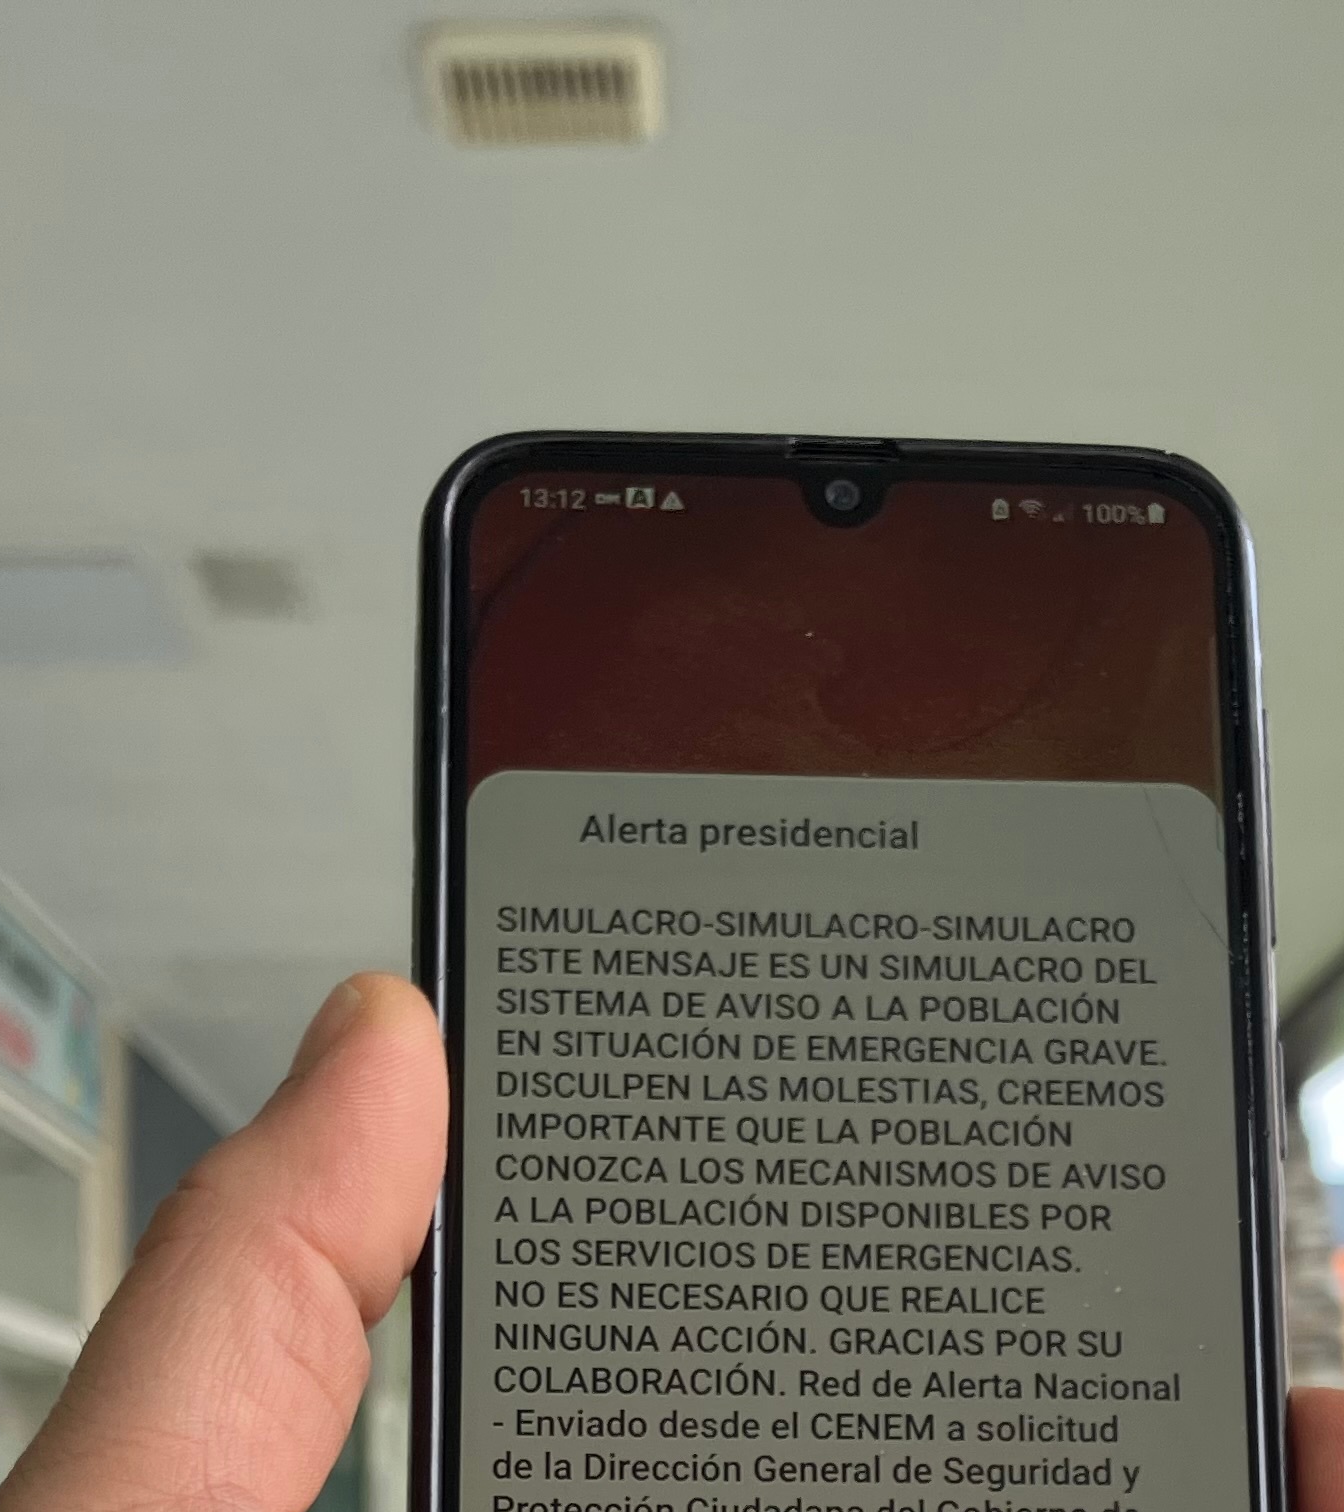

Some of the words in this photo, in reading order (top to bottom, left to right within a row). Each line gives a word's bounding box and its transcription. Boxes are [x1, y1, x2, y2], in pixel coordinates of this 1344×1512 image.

[520, 487, 587, 510] 13:12
[1082, 504, 1146, 525] 100%
[579, 812, 688, 845] Alerta
[699, 817, 919, 854] presidencial
[496, 905, 1136, 944] SIMULACRO-SIMULACRO-SIMULACRO
[497, 946, 583, 975] ESTE
[592, 948, 759, 979] MENSAJE
[769, 952, 811, 979] ES
[820, 953, 868, 981] UN
[879, 953, 1083, 984] SIMULACRO
[1095, 957, 1158, 985] DEL
[496, 987, 651, 1018] SISTEMA
[662, 991, 707, 1019] DE
[715, 992, 821, 1021] AVISO
[830, 994, 856, 1021] A
[865, 994, 909, 1022] LA
[919, 991, 1120, 1025] POBLACIÓN
[496, 1029, 541, 1057] EN
[552, 1026, 741, 1060] SITUACIÓN
[753, 1034, 797, 1062] DE
[807, 1034, 1034, 1065] EMERGENCIA
[1044, 1038, 1168, 1067] GRAVE.
[496, 1070, 690, 1101] DISCULPEN
[703, 1074, 768, 1103] LAS
[779, 1076, 988, 1111] MOLESTIAS,
[997, 1078, 1165, 1108] CREEMOS
[496, 1112, 726, 1143] IMPORTANTE
[735, 1116, 807, 1147] QUE
[816, 1117, 860, 1145] LA
[870, 1113, 1072, 1148] POBLACIÓN
[495, 1153, 669, 1184] CONOZCA
[679, 1156, 745, 1185] LOS
[755, 1158, 997, 1189] MECANISMOS
[1007, 1161, 1052, 1189] DE
[1060, 1162, 1166, 1191] AVISO
[493, 1195, 519, 1223] A
[530, 1196, 574, 1224] LA
[585, 1193, 789, 1228] POBLACIÓN
[801, 1200, 1030, 1231] DISPONIBLES
[1040, 1203, 1112, 1232] POR
[495, 1237, 561, 1266] LOS
[571, 1238, 757, 1269] SERVICIOS
[767, 1242, 811, 1270] DE
[821, 1242, 1081, 1273] EMERGENCIAS.
[495, 1279, 546, 1309] NO
[557, 1280, 599, 1310] ES
[610, 1282, 809, 1313] NECESARIO
[819, 1284, 891, 1316] QUE
[901, 1285, 1046, 1315] REALICE
[494, 1322, 660, 1353] NINGUNA
[669, 1319, 817, 1355] ACCIÓN.
[829, 1327, 985, 1357] GRACIAS
[995, 1329, 1068, 1358] POR
[1076, 1329, 1123, 1358] SU
[493, 1361, 786, 1397] COLABORACIÓN.
[799, 1368, 861, 1398] Red
[871, 1368, 913, 1399] de
[922, 1369, 1023, 1400] Alerta
[1034, 1372, 1181, 1402] Nacional
[515, 1408, 648, 1438] Enviado
[658, 1409, 761, 1440] desde
[770, 1410, 799, 1440] el
[810, 1412, 935, 1441] CENEM
[946, 1420, 966, 1442] a
[976, 1413, 1119, 1444] solicitud
[492, 1450, 533, 1480] de
[544, 1450, 573, 1481] la
[584, 1452, 742, 1483] Dirección
[753, 1454, 881, 1485] General
[892, 1455, 933, 1485] de
[943, 1456, 1112, 1493] Seguridad
[1122, 1465, 1141, 1494] y
